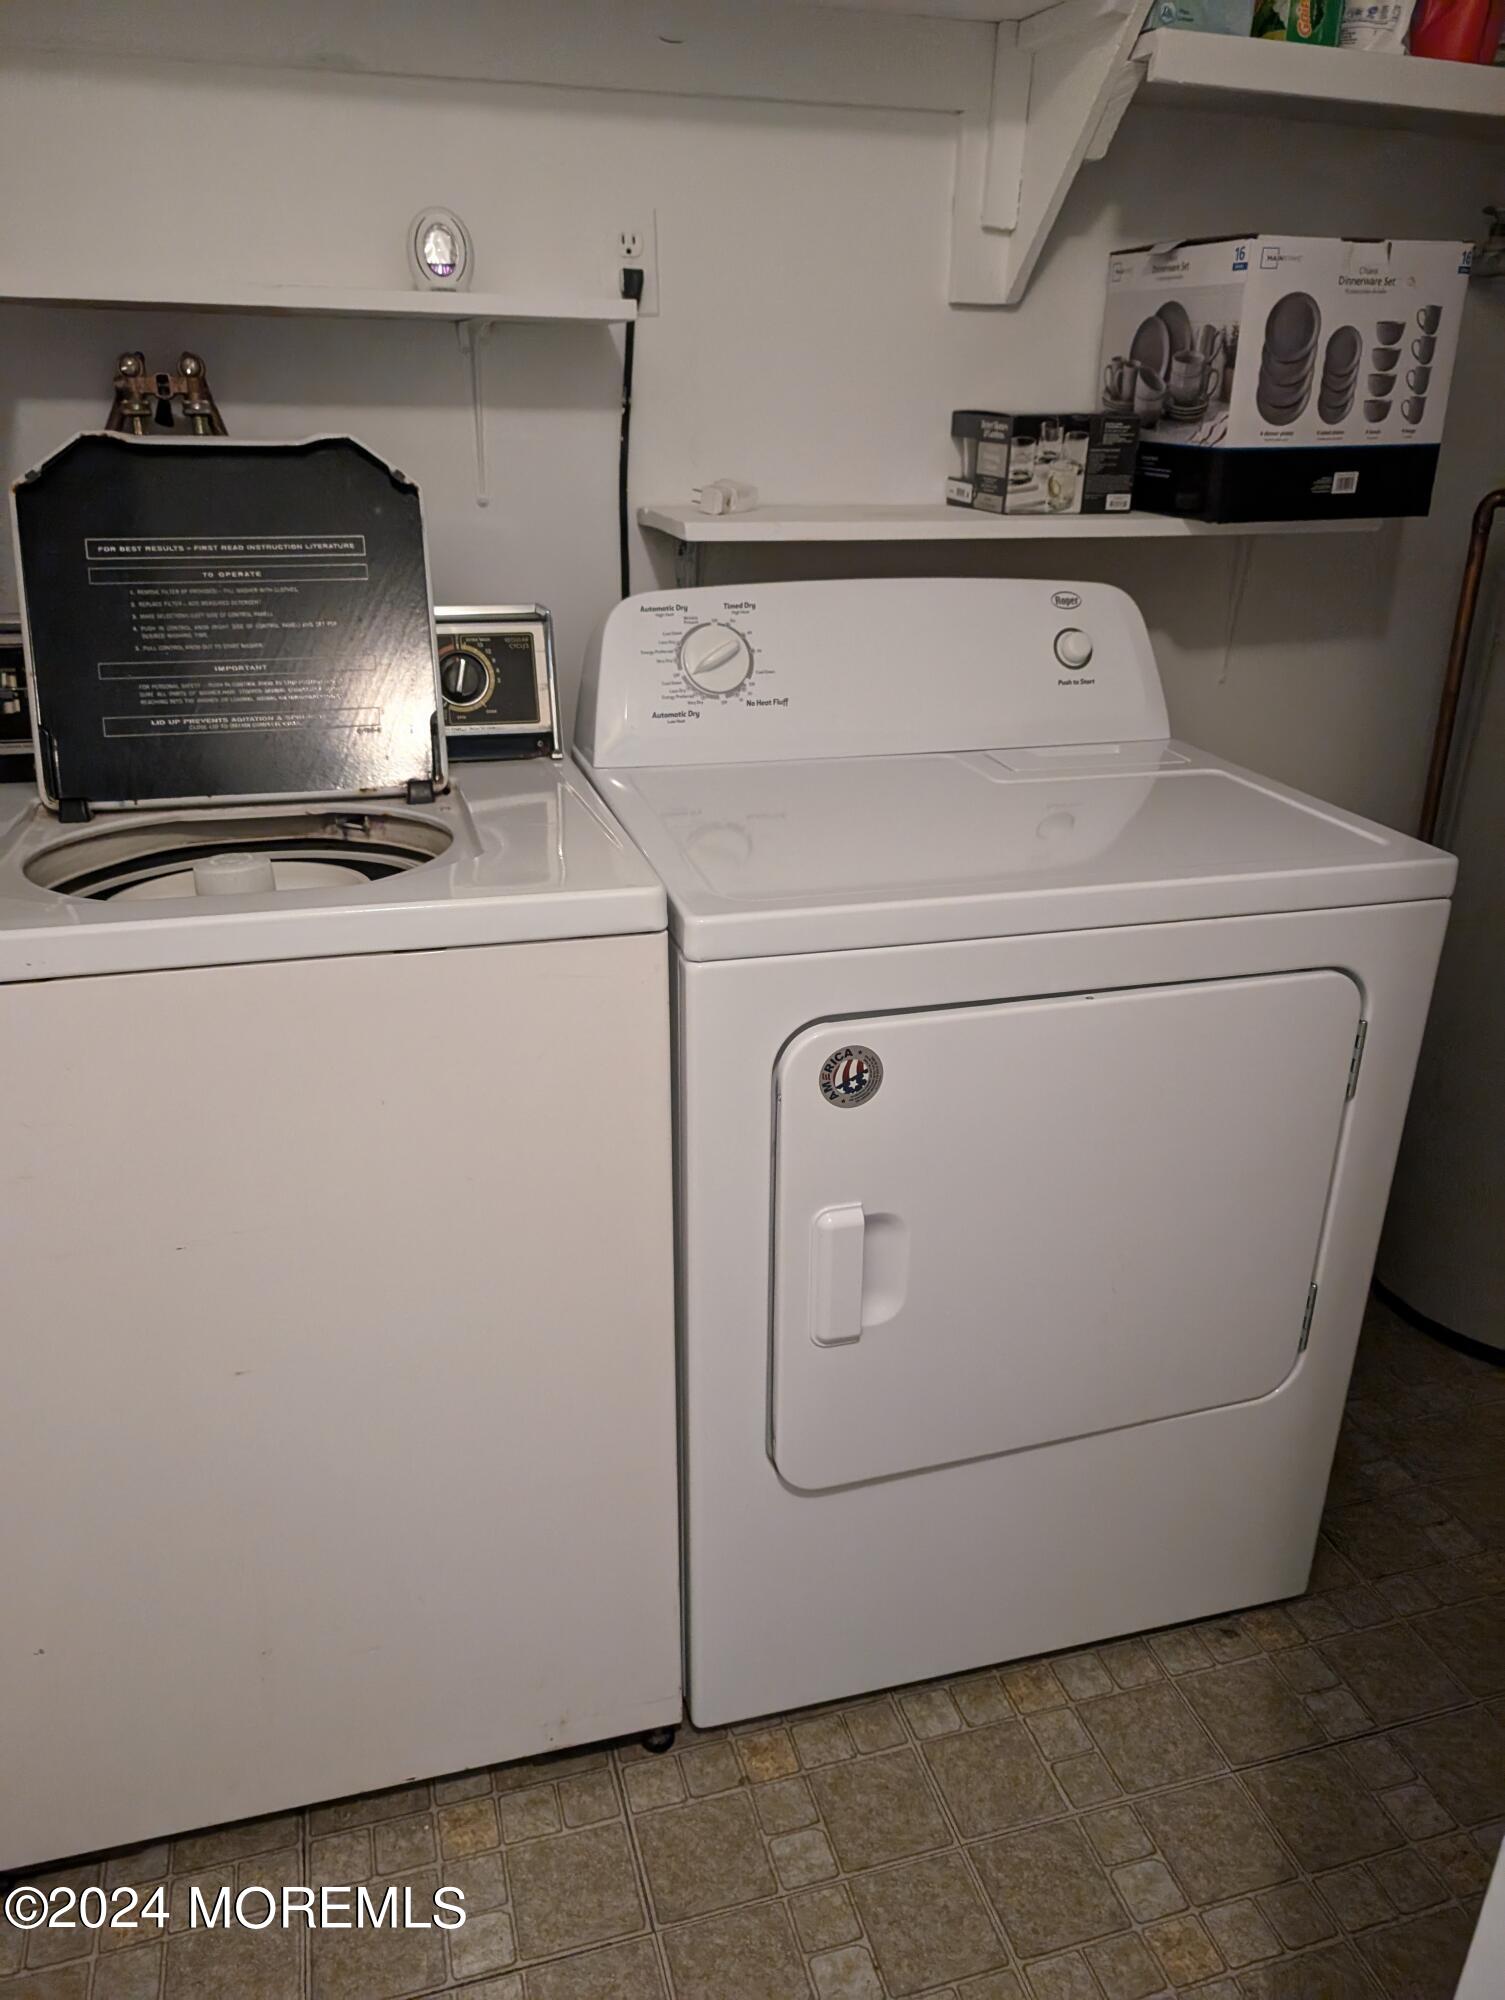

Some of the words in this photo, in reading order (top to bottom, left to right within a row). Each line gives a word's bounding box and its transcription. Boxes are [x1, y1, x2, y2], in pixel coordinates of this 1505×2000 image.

[1234, 246, 1246, 261] 16
[1338, 276, 1382, 286] Dinnerware
[1384, 275, 1397, 286] Set
[119, 545, 142, 553] BEST
[246, 543, 303, 551] INSTRUCTION
[675, 604, 688, 613] Dry
[743, 602, 756, 610] Dry
[214, 664, 268, 672] IMPORTANT
[773, 697, 788, 707] Fluff
[688, 710, 700, 719] Dry
[183, 717, 229, 725] PREVENTS
[230, 715, 274, 723] AGITATION
[822, 1048, 854, 1101] AMERICA
